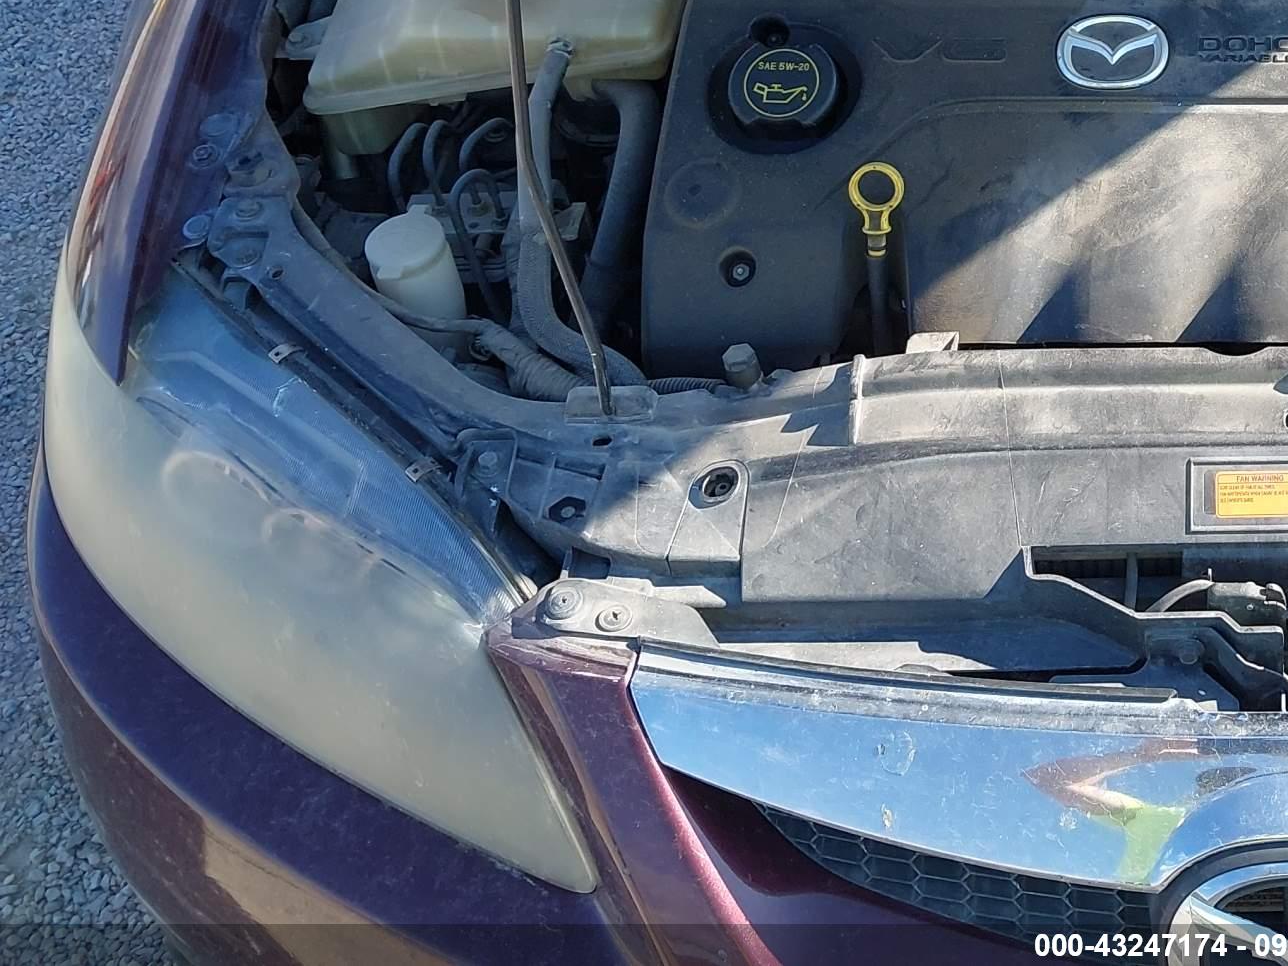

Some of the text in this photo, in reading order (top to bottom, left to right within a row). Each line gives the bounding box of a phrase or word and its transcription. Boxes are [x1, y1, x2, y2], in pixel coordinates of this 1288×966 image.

[872, 36, 1007, 63] V6
[758, 61, 810, 71] SAE 5W-20
[1251, 474, 1284, 482] WARNING
